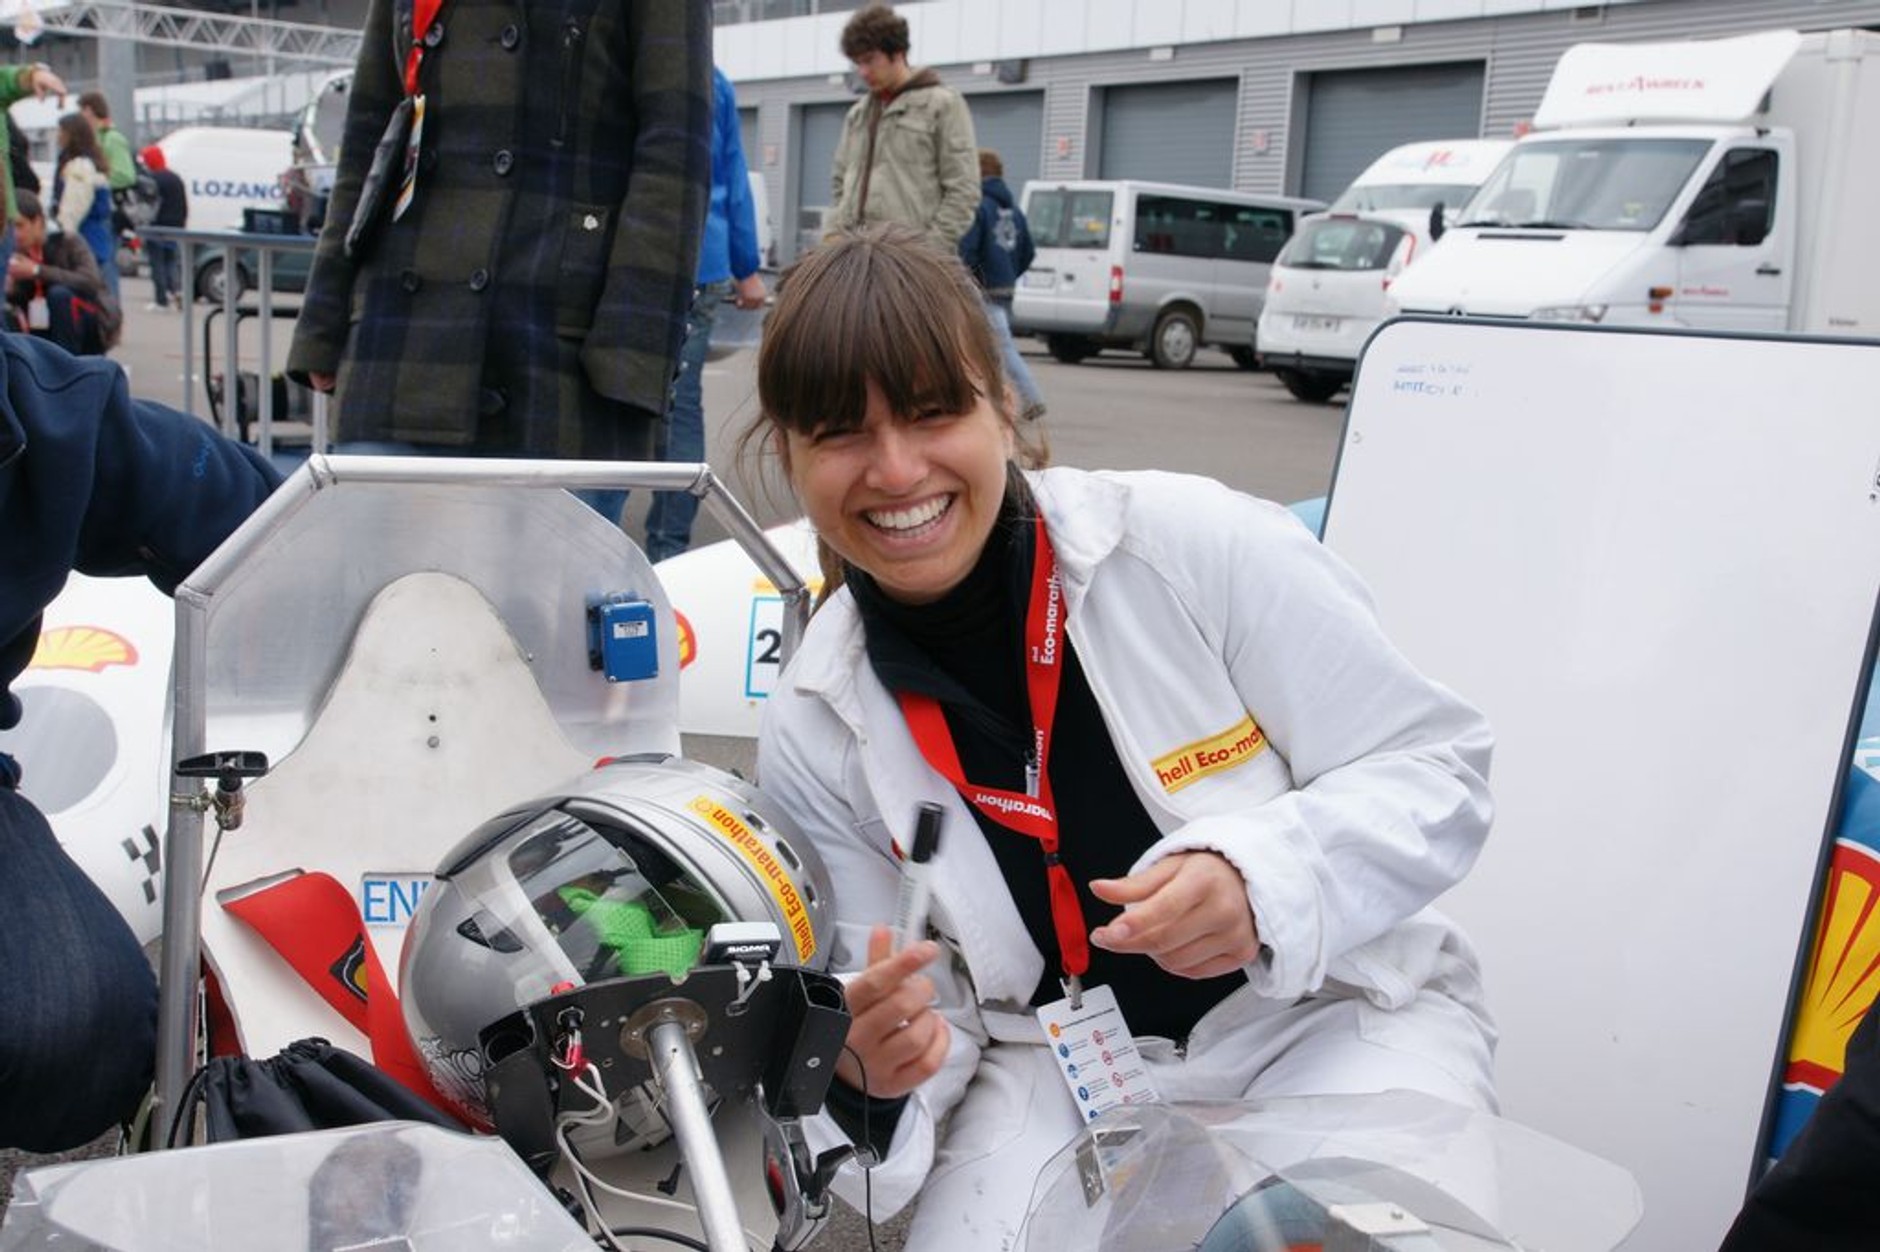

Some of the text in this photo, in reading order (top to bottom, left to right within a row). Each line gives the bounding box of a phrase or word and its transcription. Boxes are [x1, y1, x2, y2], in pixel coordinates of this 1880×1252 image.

[192, 180, 284, 200] LOZANO
[1040, 561, 1063, 665] Eco-maratho
[1156, 727, 1262, 787] hell Eco-ma
[363, 881, 429, 922] EN
[712, 809, 814, 960] Shell Eco-marathon
[727, 944, 771, 954] SIGMA
